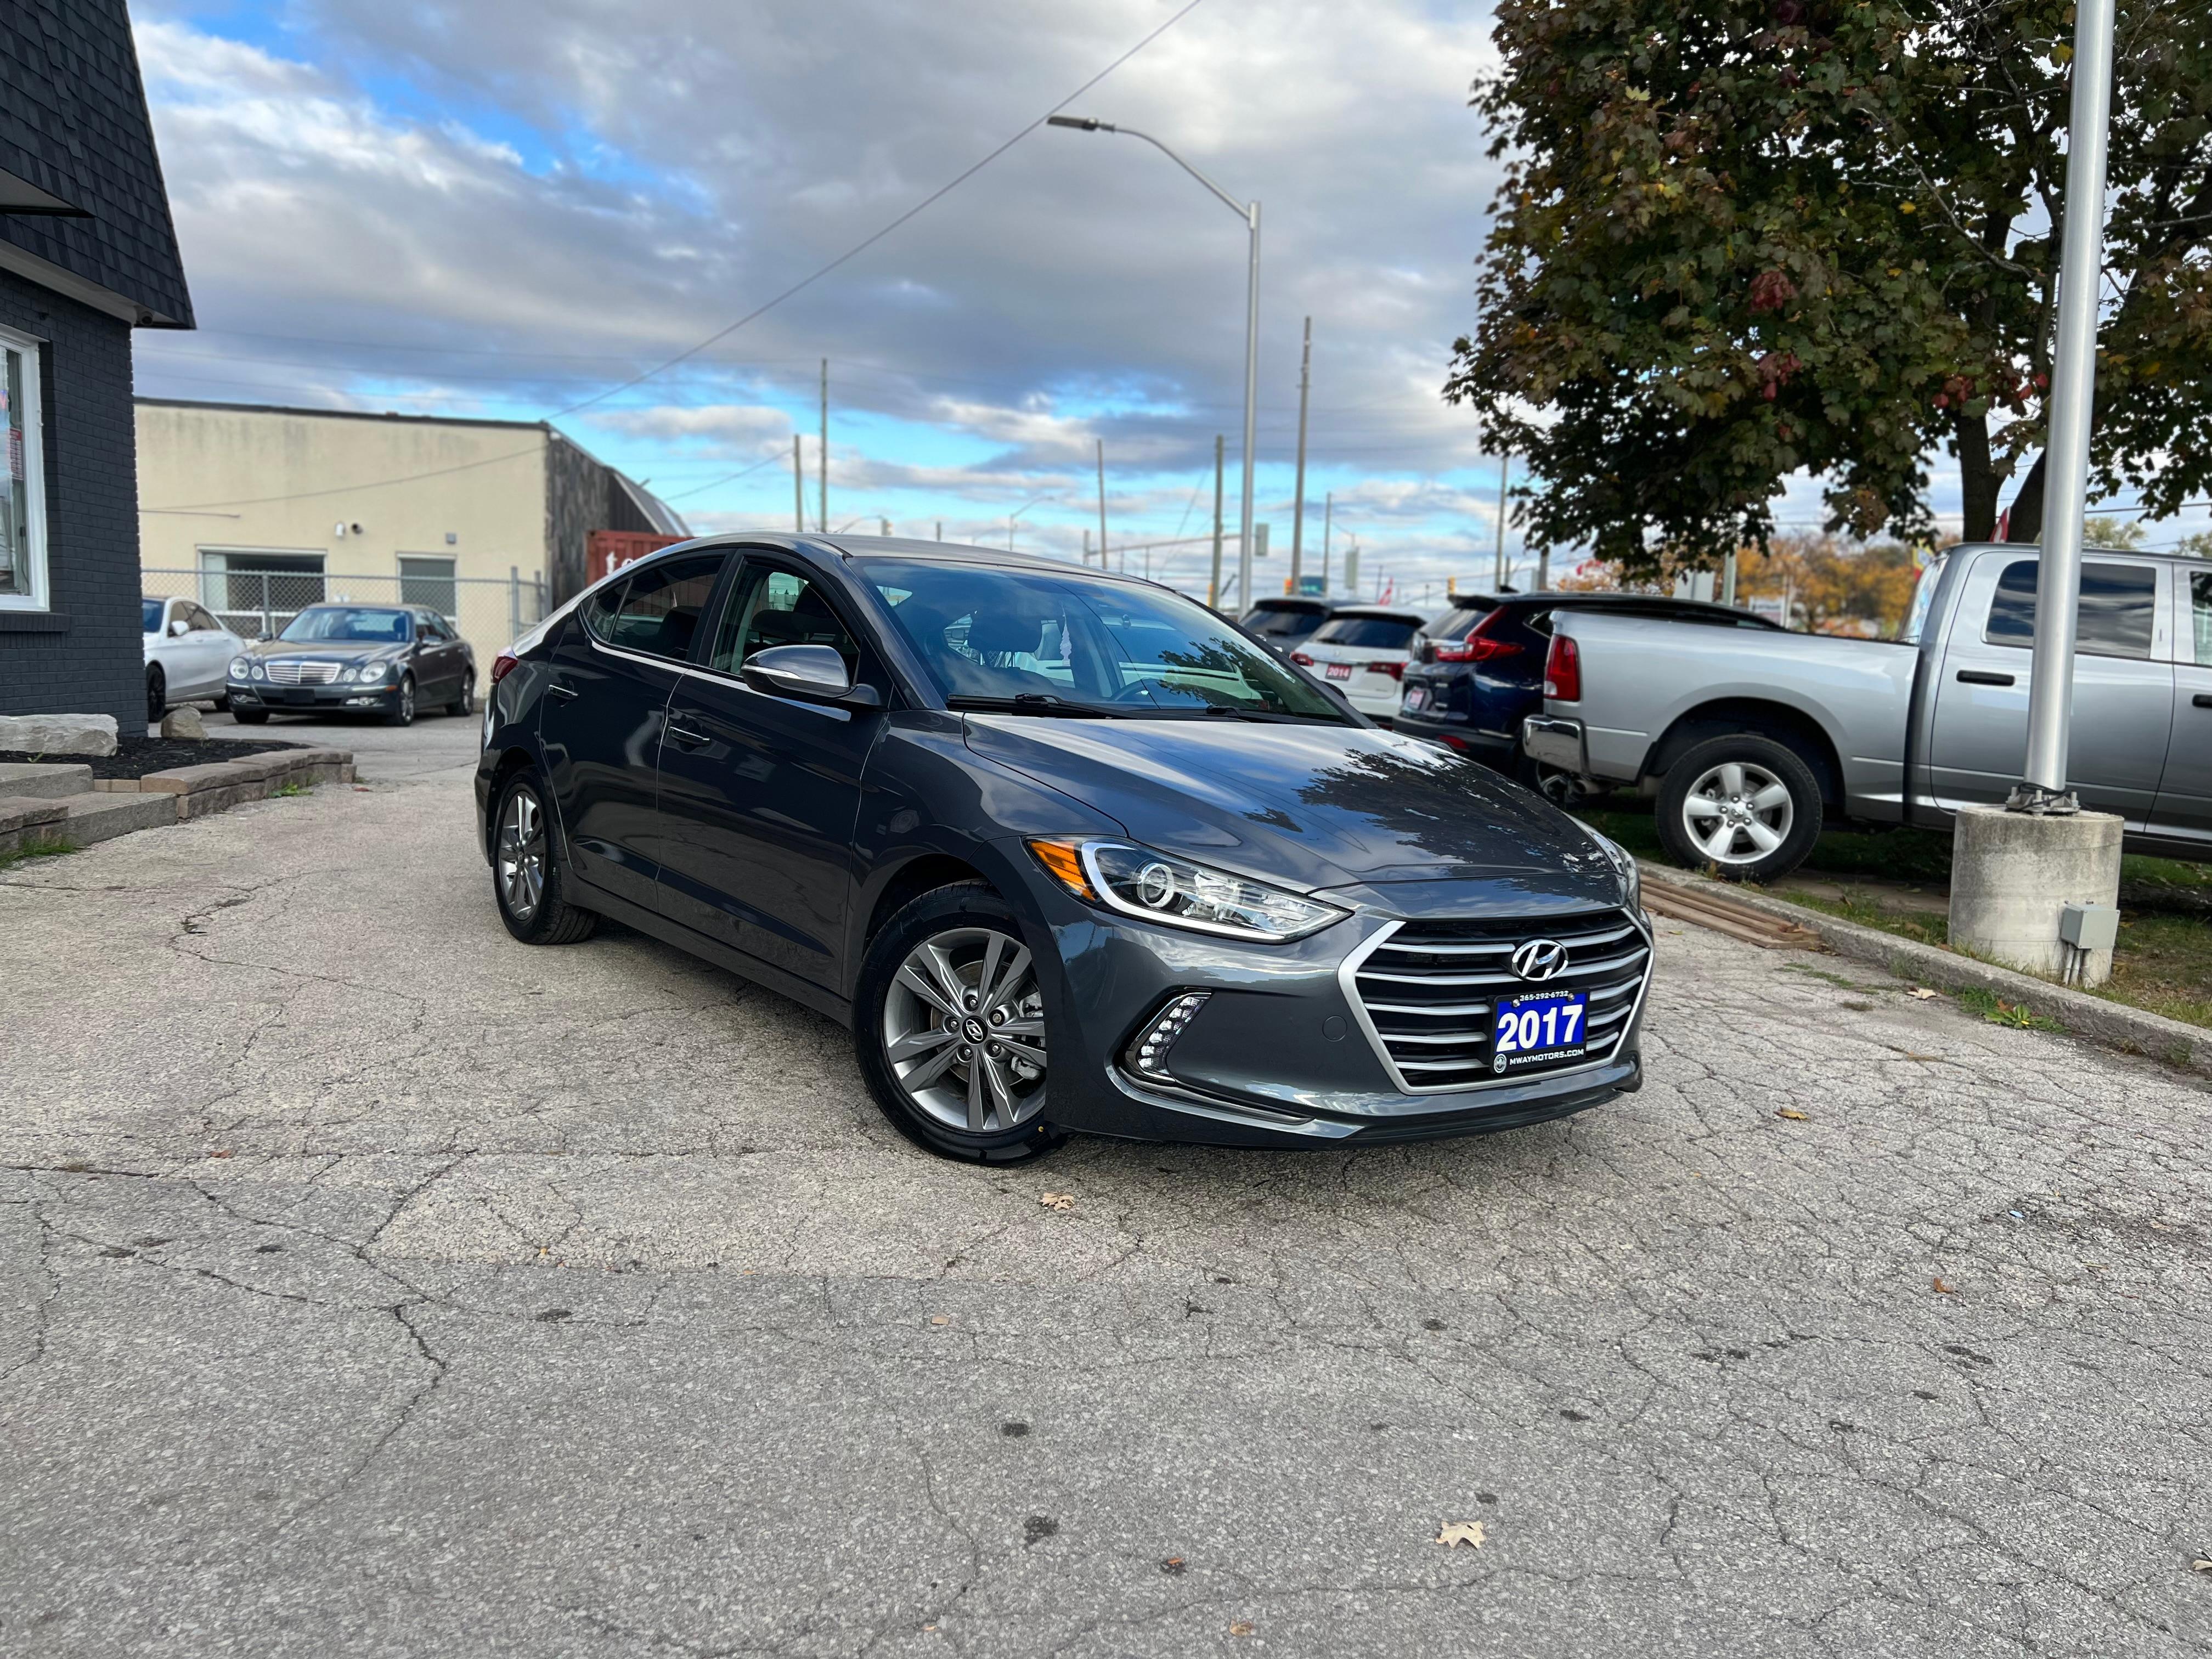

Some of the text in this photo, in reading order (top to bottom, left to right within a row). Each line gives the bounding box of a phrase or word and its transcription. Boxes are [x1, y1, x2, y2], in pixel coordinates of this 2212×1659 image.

[1328, 667, 1350, 677] 2014
[1496, 1005, 1583, 1052] 2017
[1509, 1048, 1584, 1065] MWAYMOTORS.COM
